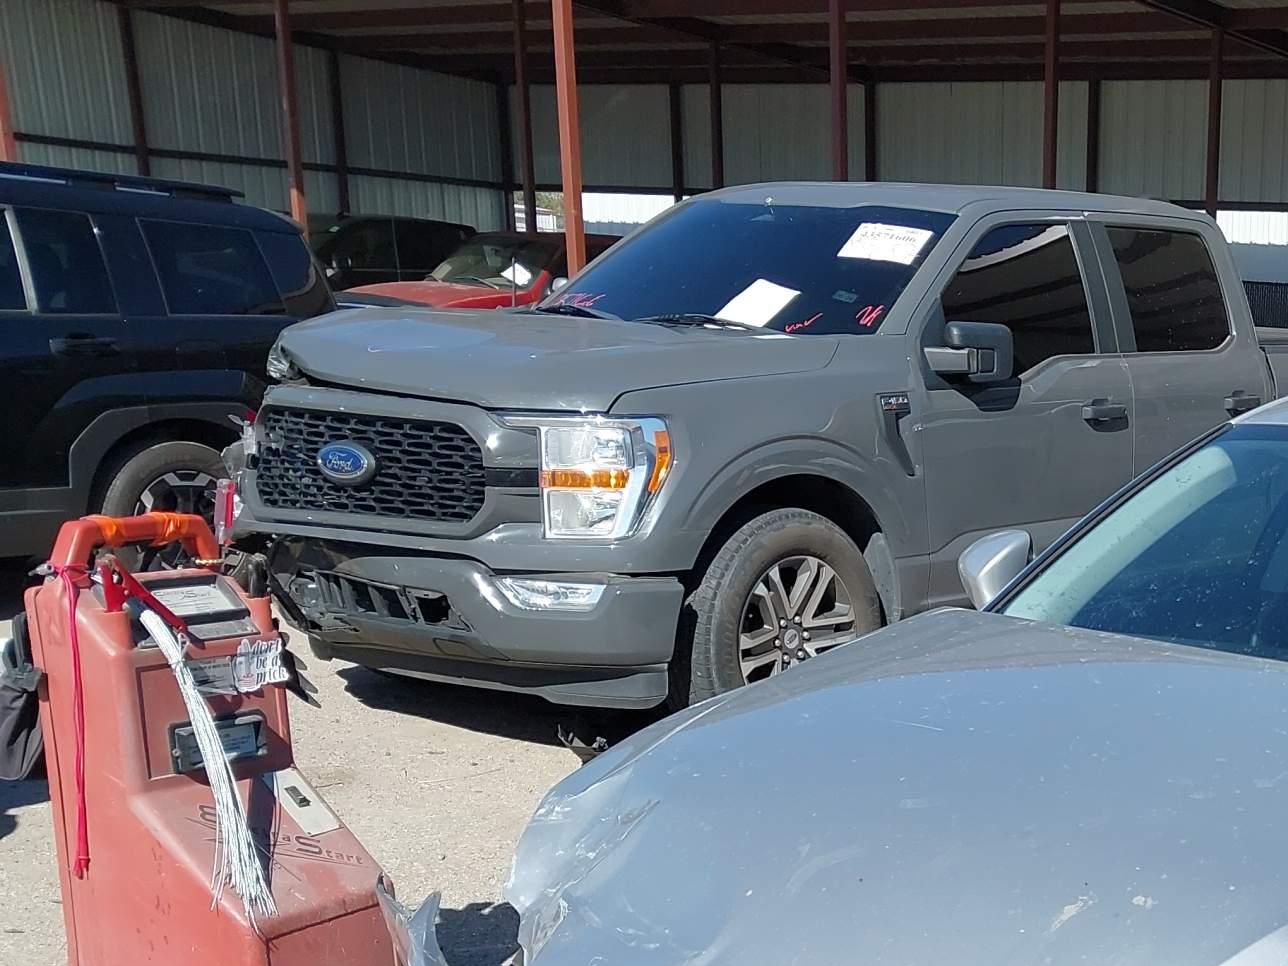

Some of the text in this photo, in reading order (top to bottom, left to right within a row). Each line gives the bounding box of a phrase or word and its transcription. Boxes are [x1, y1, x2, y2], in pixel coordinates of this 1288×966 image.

[326, 451, 354, 471] Ford
[256, 656, 279, 669] be a
[255, 668, 286, 686] prick
